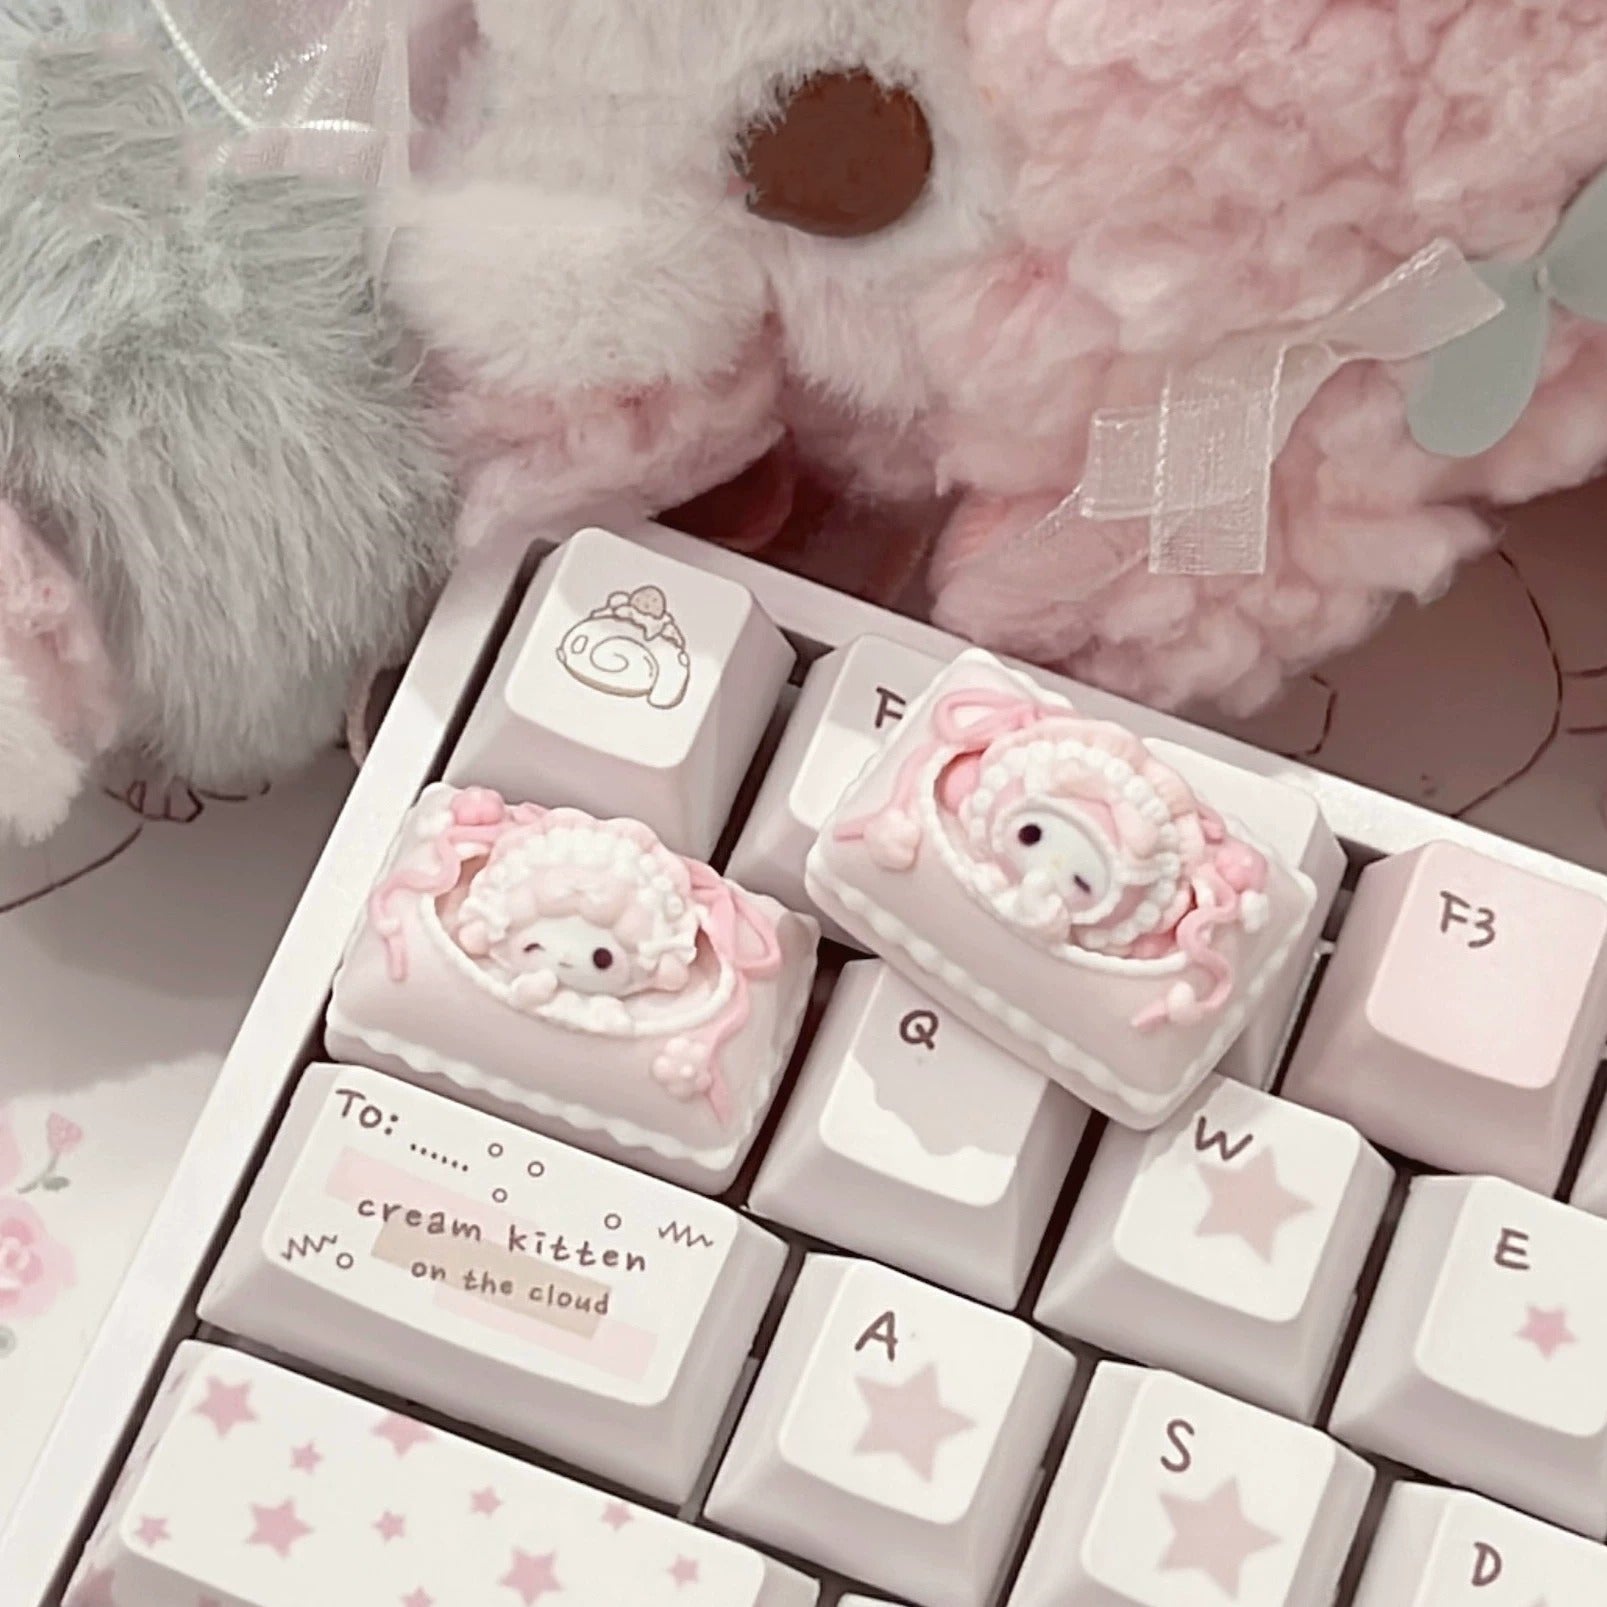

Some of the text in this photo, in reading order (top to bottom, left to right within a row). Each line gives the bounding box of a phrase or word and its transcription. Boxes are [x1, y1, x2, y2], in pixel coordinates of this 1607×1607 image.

[874, 686, 907, 729] F
[1439, 890, 1496, 949] F3
[899, 1009, 939, 1051] Q
[335, 1088, 399, 1136] To:
[1194, 1114, 1254, 1161] W
[357, 1199, 482, 1243] cream
[1494, 1227, 1530, 1271] E
[411, 1261, 610, 1316] on the cloud
[854, 1310, 899, 1362] A
[1160, 1419, 1195, 1473] S
[1471, 1541, 1502, 1587] D
